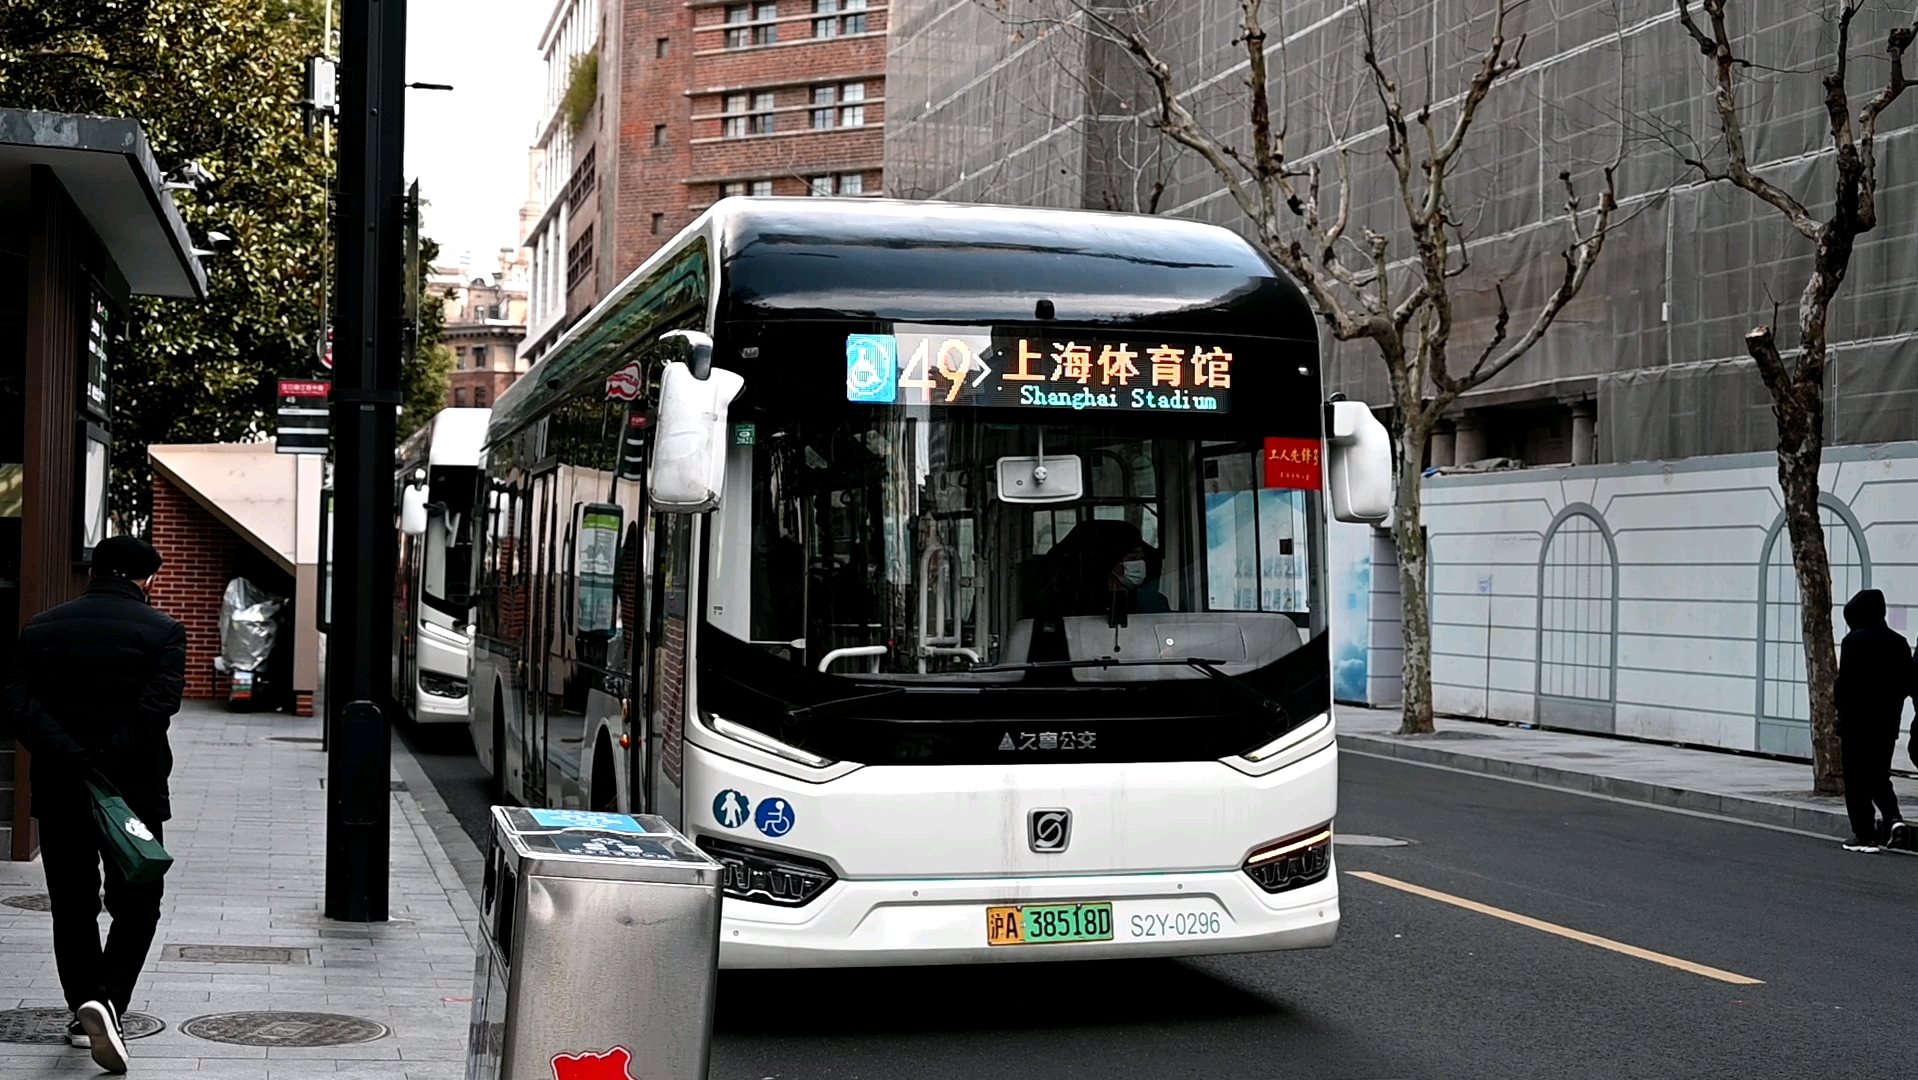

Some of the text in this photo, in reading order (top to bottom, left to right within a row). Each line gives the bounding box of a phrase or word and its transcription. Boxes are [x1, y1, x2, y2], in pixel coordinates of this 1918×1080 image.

[898, 338, 1233, 402] 49 上海体育馆
[1020, 386, 1217, 411] Shanghai Stadium
[1268, 447, 1320, 467] 工人先锋号
[1131, 911, 1221, 938] S2Y-0296
